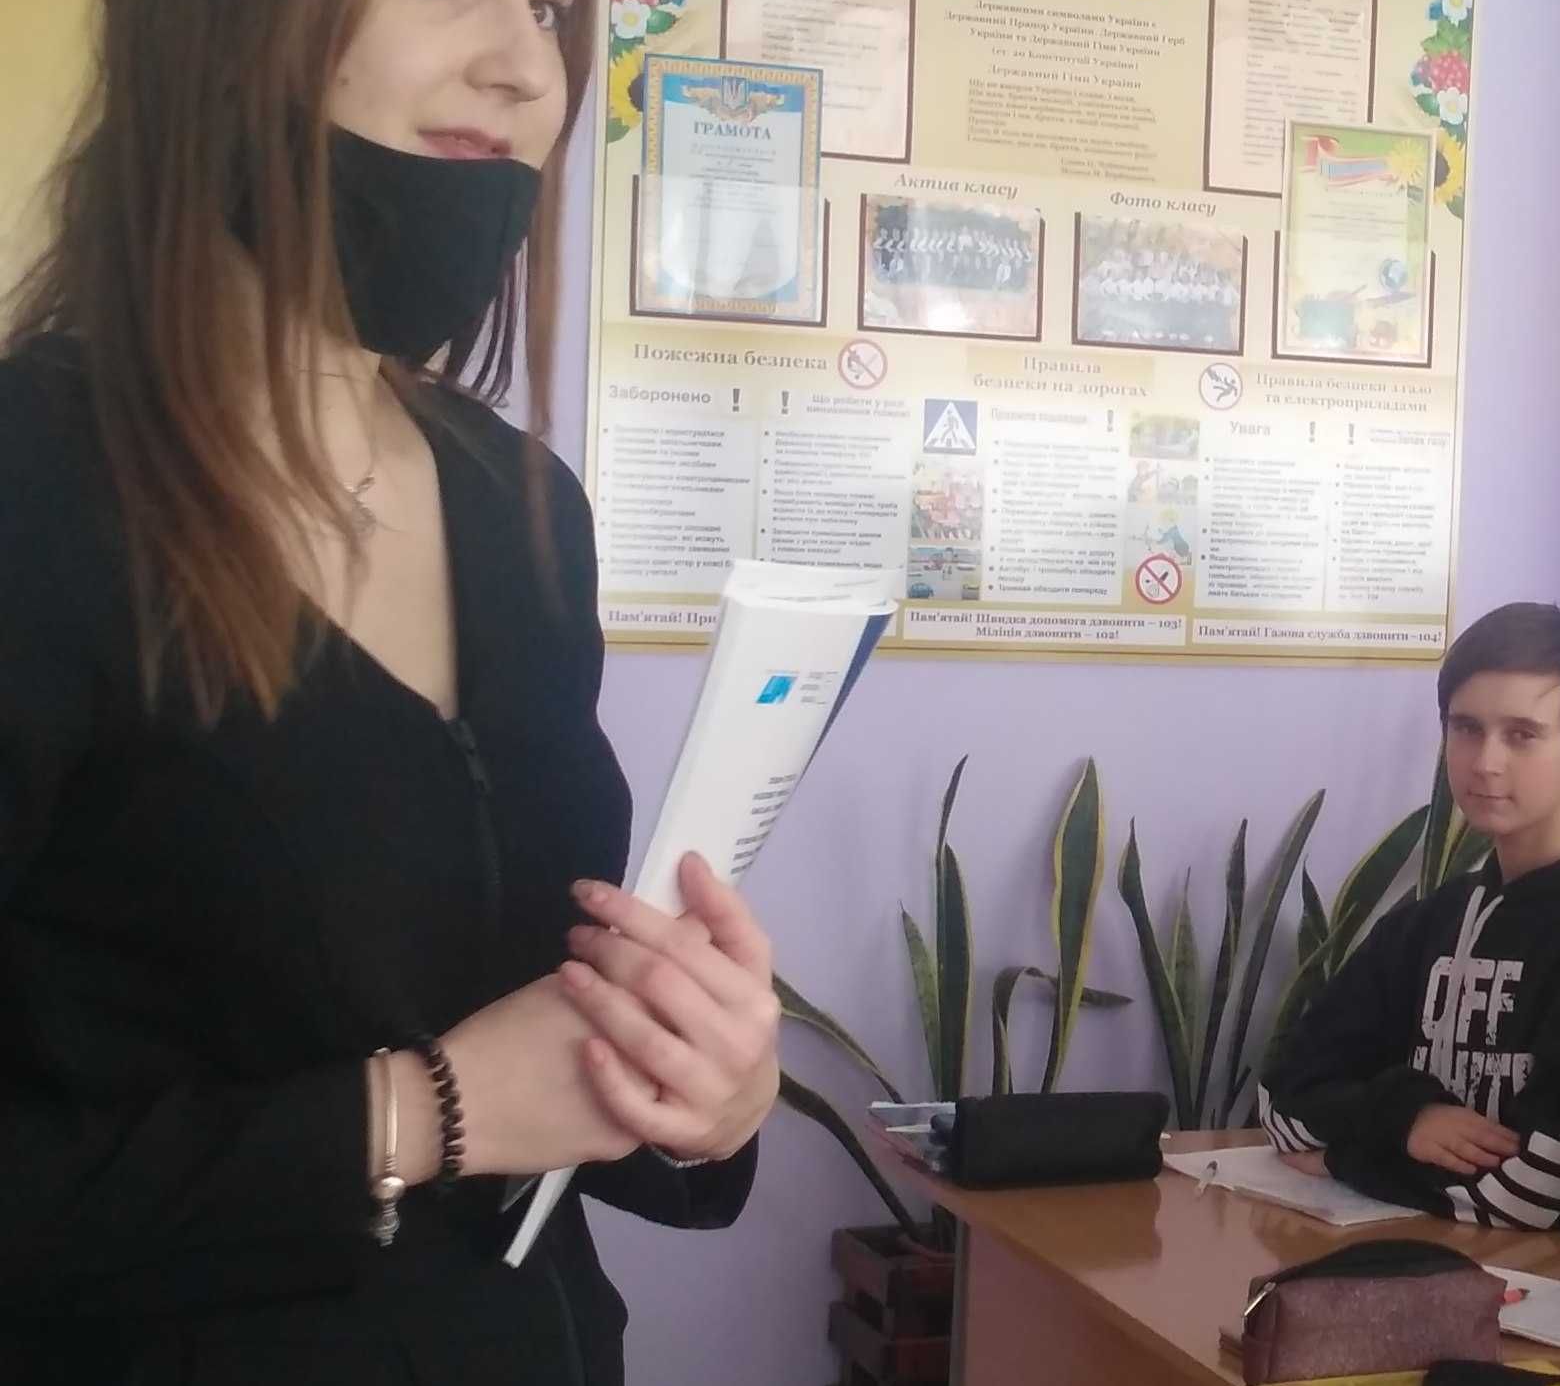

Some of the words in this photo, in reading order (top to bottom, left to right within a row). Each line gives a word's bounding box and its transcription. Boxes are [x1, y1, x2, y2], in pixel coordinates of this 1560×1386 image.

[693, 121, 772, 140] ГРАМОТА
[894, 173, 958, 195] Актив
[962, 181, 1018, 201] класу
[1110, 191, 1162, 211] Фото
[1166, 199, 1217, 217] класу
[633, 343, 738, 366] Пожежна
[743, 350, 828, 371] безпека
[608, 384, 711, 403] Заборонено
[1421, 955, 1524, 1045] OFF
